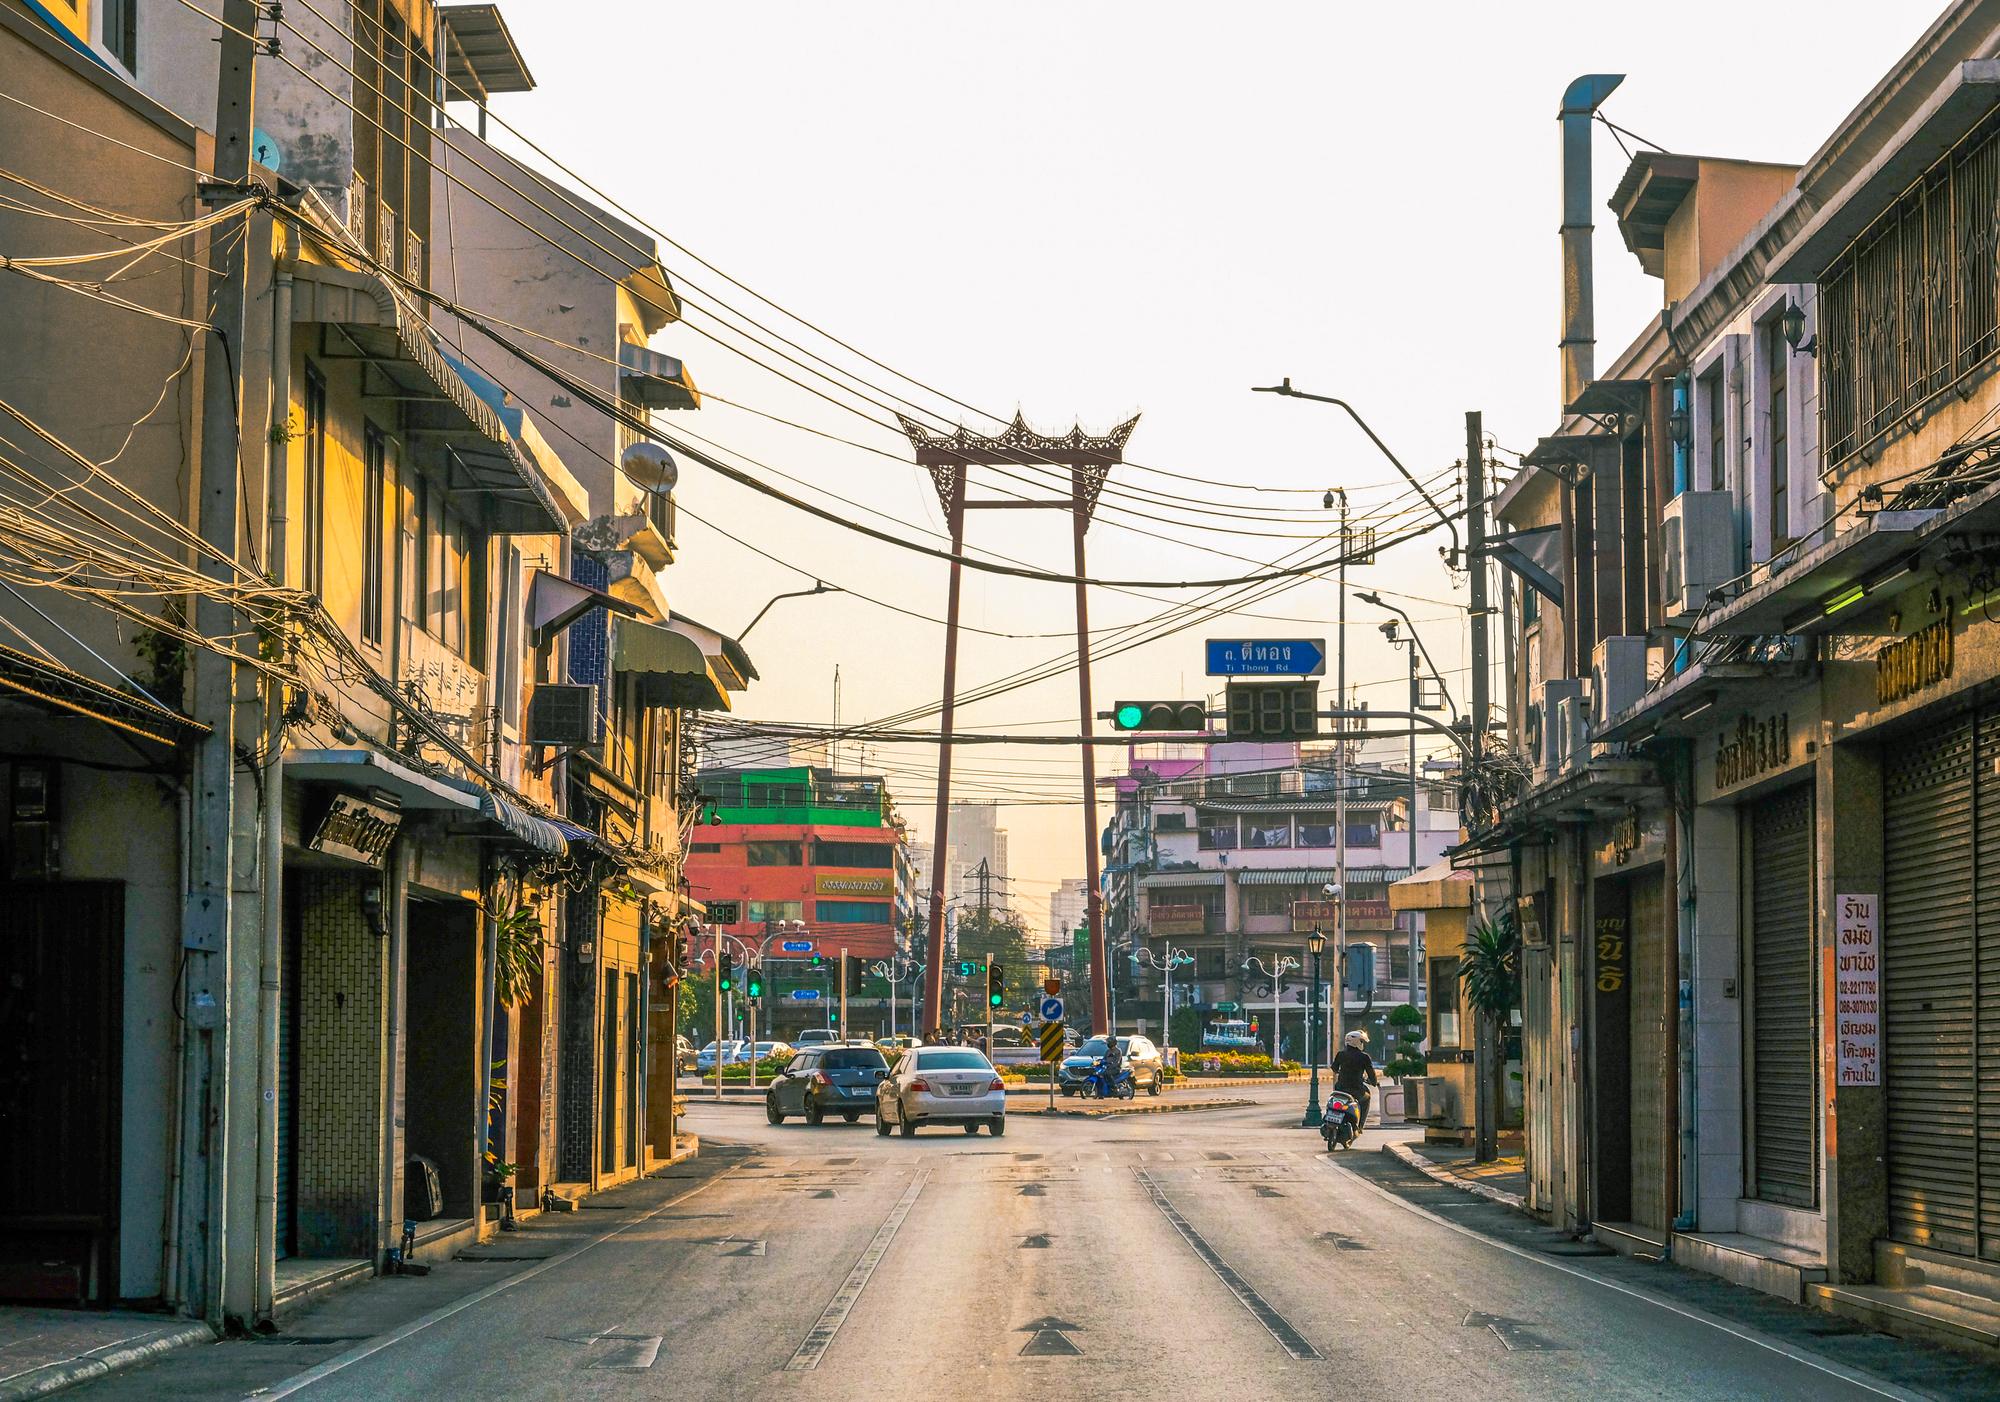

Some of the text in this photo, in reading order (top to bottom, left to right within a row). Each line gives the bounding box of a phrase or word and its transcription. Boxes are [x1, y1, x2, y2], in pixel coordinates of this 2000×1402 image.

[1241, 641, 1291, 661] ตีทอง
[1225, 664, 1234, 672] Ti
[1241, 664, 1269, 673] Thong
[1844, 896, 1870, 919] ร้าน
[961, 963, 976, 975] 57
[1839, 951, 1875, 972] พานิช
[1841, 1020, 1876, 1036] เชิญชม
[1841, 1040, 1876, 1064] โต๊ะหมู่
